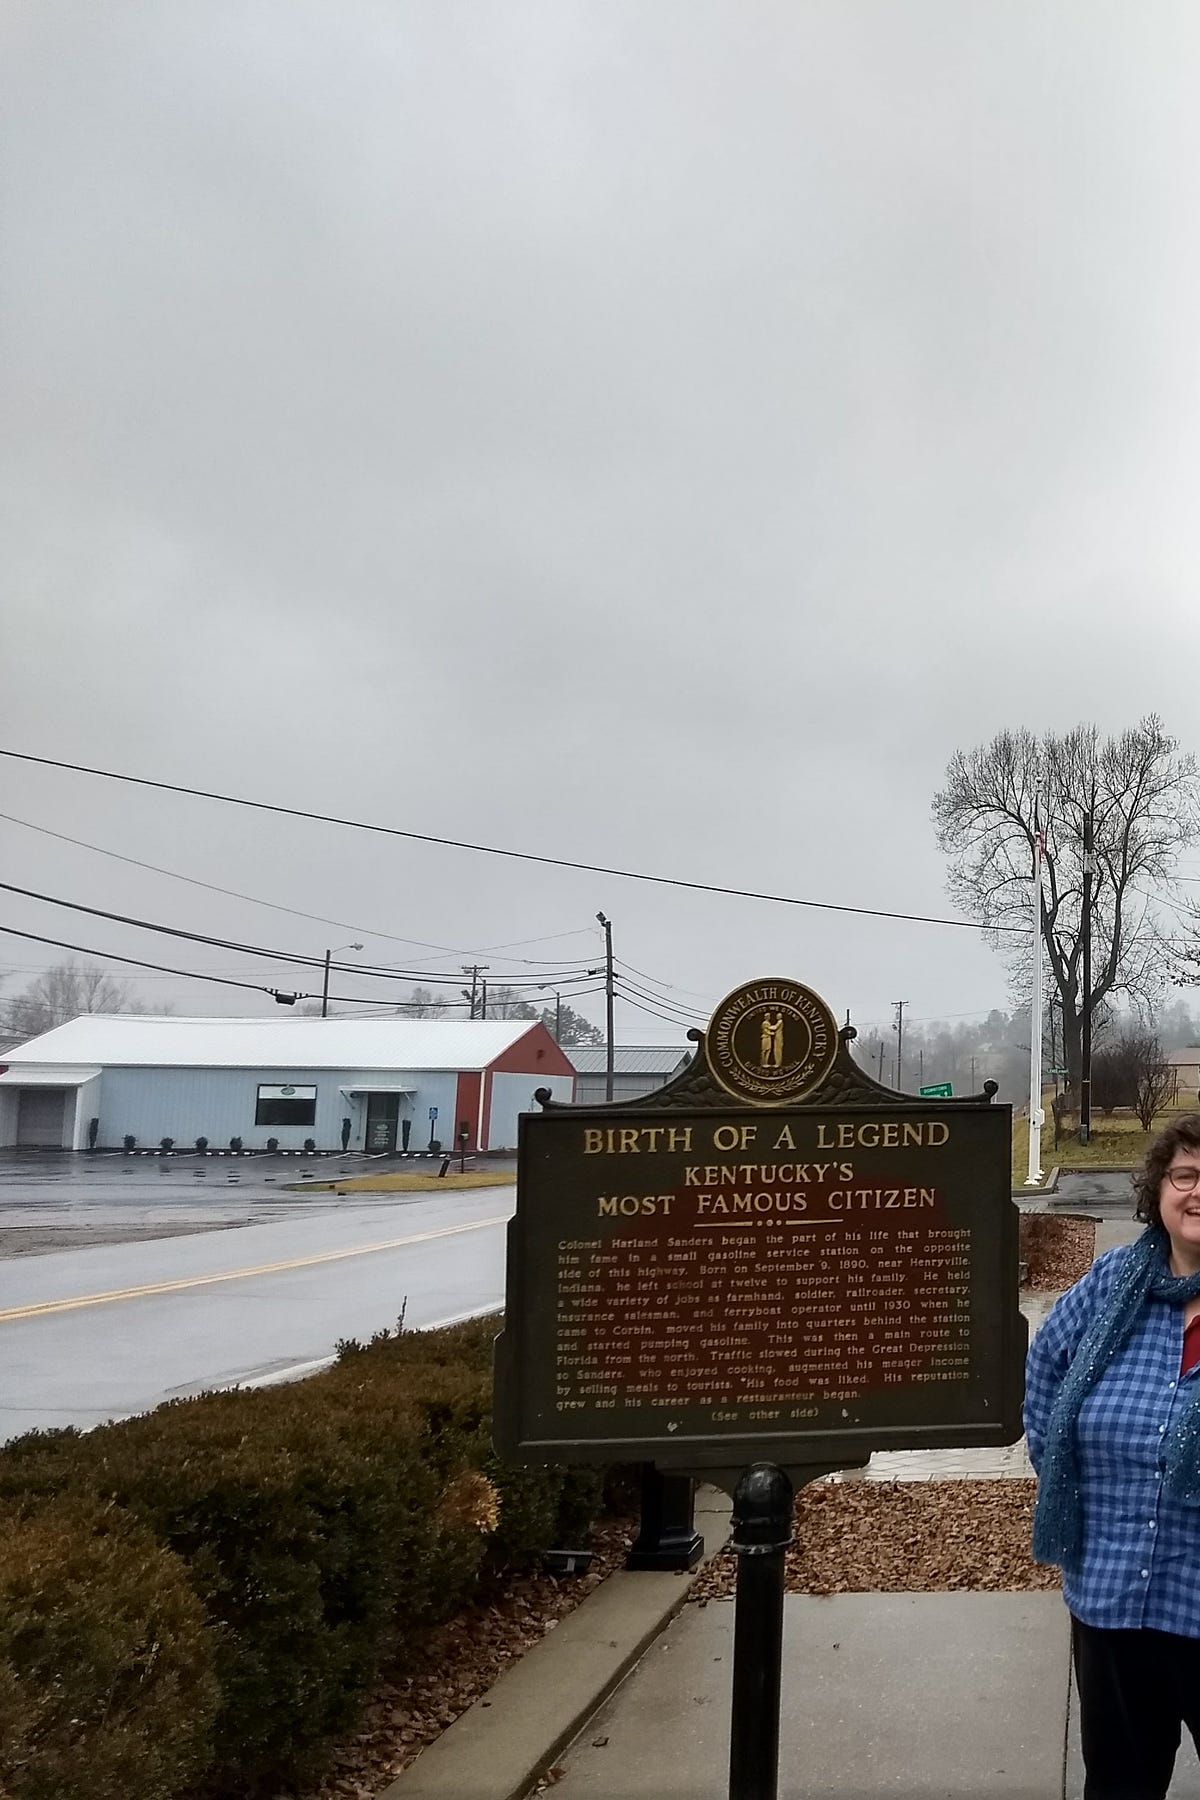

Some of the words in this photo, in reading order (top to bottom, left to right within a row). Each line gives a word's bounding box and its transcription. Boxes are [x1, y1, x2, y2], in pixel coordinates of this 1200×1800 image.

[716, 987, 778, 1068] COMMONWEALTH
[781, 988, 797, 1001] OF
[794, 995, 828, 1062] KENTUCKY
[584, 1126, 693, 1154] BIRTH
[713, 1126, 757, 1152] OF
[772, 1124, 797, 1150] A
[816, 1121, 950, 1149] LEGEND
[684, 1163, 855, 1187] KENTUCKY'S
[597, 1195, 676, 1217] MOST
[696, 1192, 808, 1214] FAMOUS
[827, 1188, 937, 1210] CITIZEN
[558, 1239, 602, 1251] Colonel
[611, 1237, 658, 1249] Harland
[667, 1237, 713, 1247] Sanders
[721, 1235, 756, 1248] began
[766, 1234, 784, 1244] the
[792, 1233, 816, 1245] part
[824, 1232, 837, 1242] of
[845, 1231, 862, 1241] his
[869, 1230, 889, 1240] life
[897, 1229, 920, 1239] that
[928, 1228, 971, 1241] brought
[558, 1254, 580, 1265] him
[590, 1253, 618, 1264] fame
[628, 1253, 640, 1263] in
[650, 1254, 657, 1262] a
[667, 1251, 697, 1262] small
[707, 1249, 756, 1261] gasoline
[767, 1248, 810, 1258] service
[820, 1246, 859, 1256] station
[870, 1246, 884, 1255] on
[894, 1244, 913, 1254] the
[923, 1242, 971, 1255] opposite
[558, 1269, 581, 1279] side
[588, 1268, 601, 1278] of
[608, 1267, 630, 1278] this
[638, 1266, 688, 1280] highway.
[700, 1265, 727, 1275] Born
[734, 1265, 748, 1274] on
[755, 1262, 815, 1274] September
[878, 1260, 903, 1268] near
[616, 1281, 631, 1292] he
[637, 1280, 659, 1291] left
[711, 1279, 723, 1289] at
[730, 1277, 768, 1288] twelve
[776, 1277, 788, 1286] to
[796, 1275, 840, 1287] support
[847, 1274, 864, 1283] his
[923, 1271, 939, 1281] He
[947, 1270, 971, 1280] held
[571, 1297, 598, 1307] wide
[606, 1296, 650, 1308] variety
[656, 1294, 669, 1305] of
[674, 1294, 700, 1307] jobs
[707, 1294, 720, 1303] as
[693, 1308, 713, 1318] and
[724, 1306, 781, 1319] ferryboat
[791, 1304, 842, 1317] operator
[850, 1301, 876, 1312] until
[884, 1300, 911, 1310] 1930
[920, 1299, 948, 1309] when
[957, 1298, 970, 1308] he
[556, 1328, 587, 1337] came
[594, 1327, 607, 1336] to
[666, 1323, 704, 1334] moved
[709, 1322, 726, 1332] his
[733, 1320, 770, 1333] family
[776, 1319, 799, 1329] into
[805, 1318, 856, 1331] quarters
[863, 1315, 902, 1326] behind
[909, 1314, 927, 1324] the
[932, 1313, 971, 1323] station
[556, 1342, 578, 1352] and
[587, 1340, 630, 1351] started
[640, 1338, 690, 1352] pumping
[767, 1333, 793, 1344] This
[803, 1334, 824, 1343] was
[833, 1331, 858, 1341] then
[868, 1332, 875, 1340] a
[884, 1330, 911, 1340] main
[920, 1329, 951, 1338] route
[958, 1328, 970, 1337] to
[556, 1355, 598, 1366] Florida
[605, 1354, 632, 1365] from
[638, 1353, 657, 1363] the
[710, 1350, 753, 1361] Traffic
[759, 1348, 798, 1359] slowed
[803, 1346, 841, 1359] during
[847, 1345, 865, 1355] the
[872, 1344, 903, 1354] Great
[909, 1342, 970, 1354] Depression
[556, 1372, 569, 1381] so
[639, 1368, 662, 1378] who
[670, 1366, 718, 1379] enjoyed
[788, 1360, 848, 1373] augmented
[856, 1359, 873, 1369] his
[882, 1359, 923, 1370] meager
[930, 1356, 970, 1366] income
[555, 1384, 572, 1398] by
[579, 1383, 618, 1397] selling
[626, 1382, 659, 1393] meals
[666, 1383, 679, 1392] to
[773, 1376, 800, 1388] food
[808, 1377, 830, 1386] was
[883, 1372, 903, 1383] His
[910, 1370, 970, 1384] reputation
[556, 1400, 586, 1413] grew
[594, 1399, 616, 1409] and
[624, 1397, 642, 1408] his
[651, 1397, 690, 1407] career
[699, 1396, 712, 1405] as
[749, 1409, 781, 1420] other
